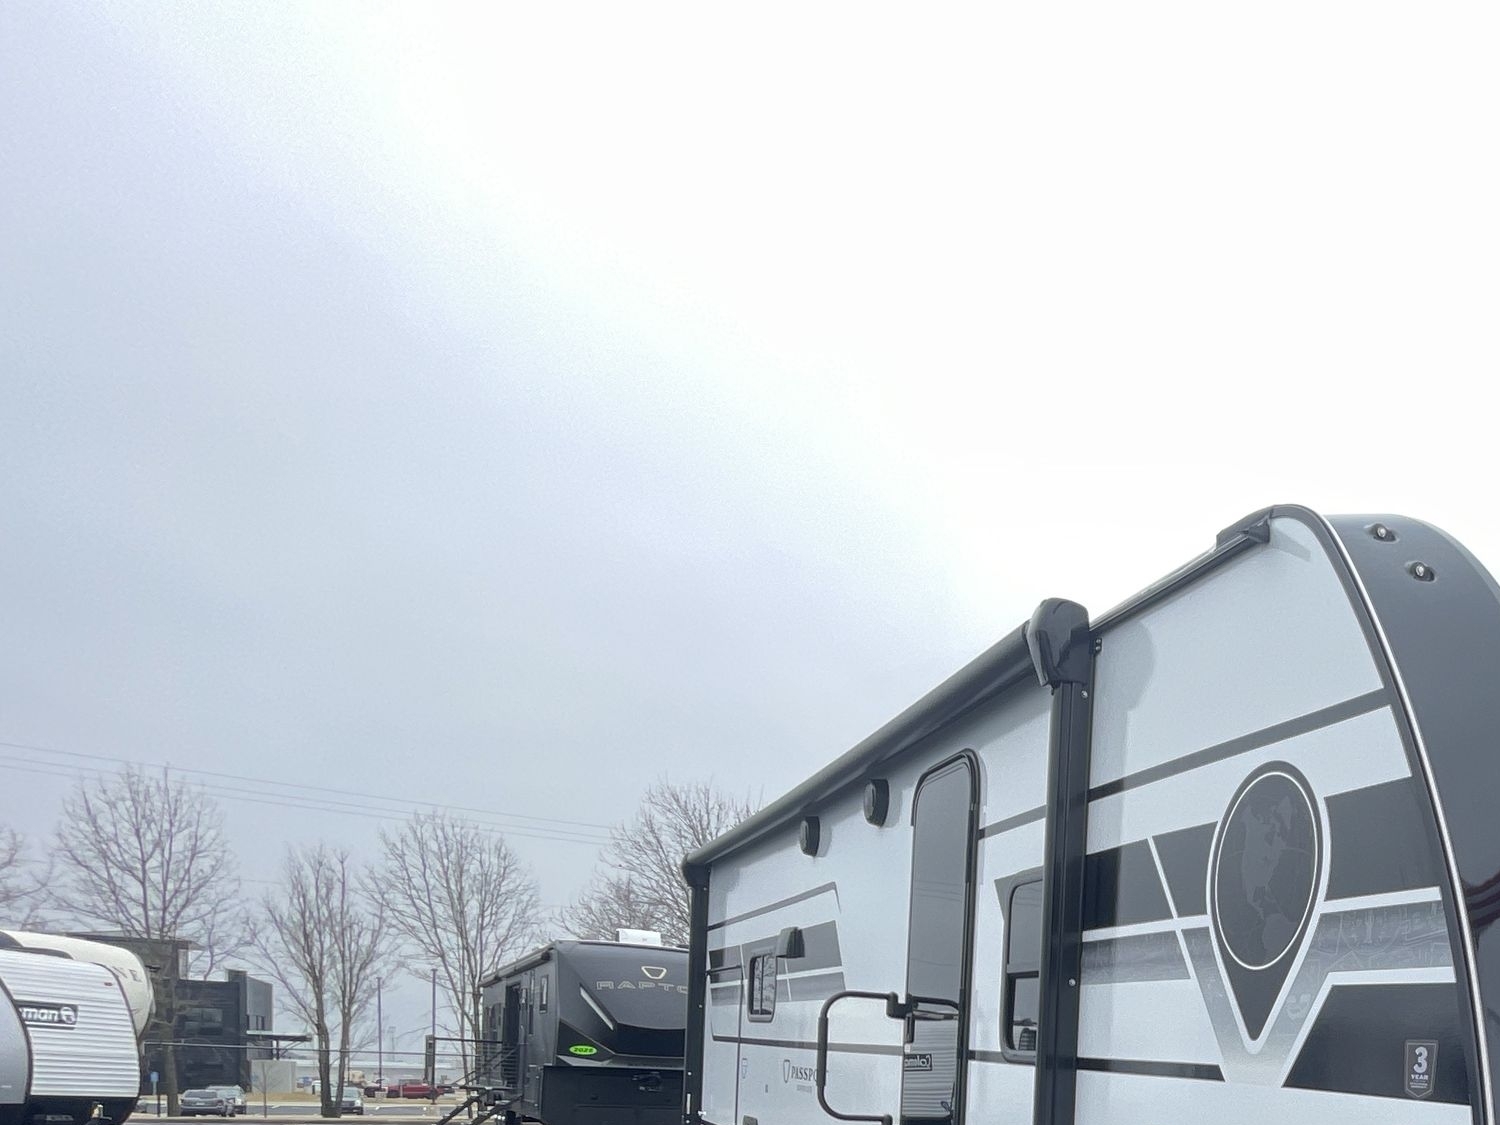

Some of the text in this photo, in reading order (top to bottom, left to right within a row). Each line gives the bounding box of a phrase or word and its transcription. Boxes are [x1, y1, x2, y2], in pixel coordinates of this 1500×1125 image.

[596, 980, 688, 995] RAPTO
[19, 1007, 59, 1022] man
[1413, 1046, 1428, 1074] 3
